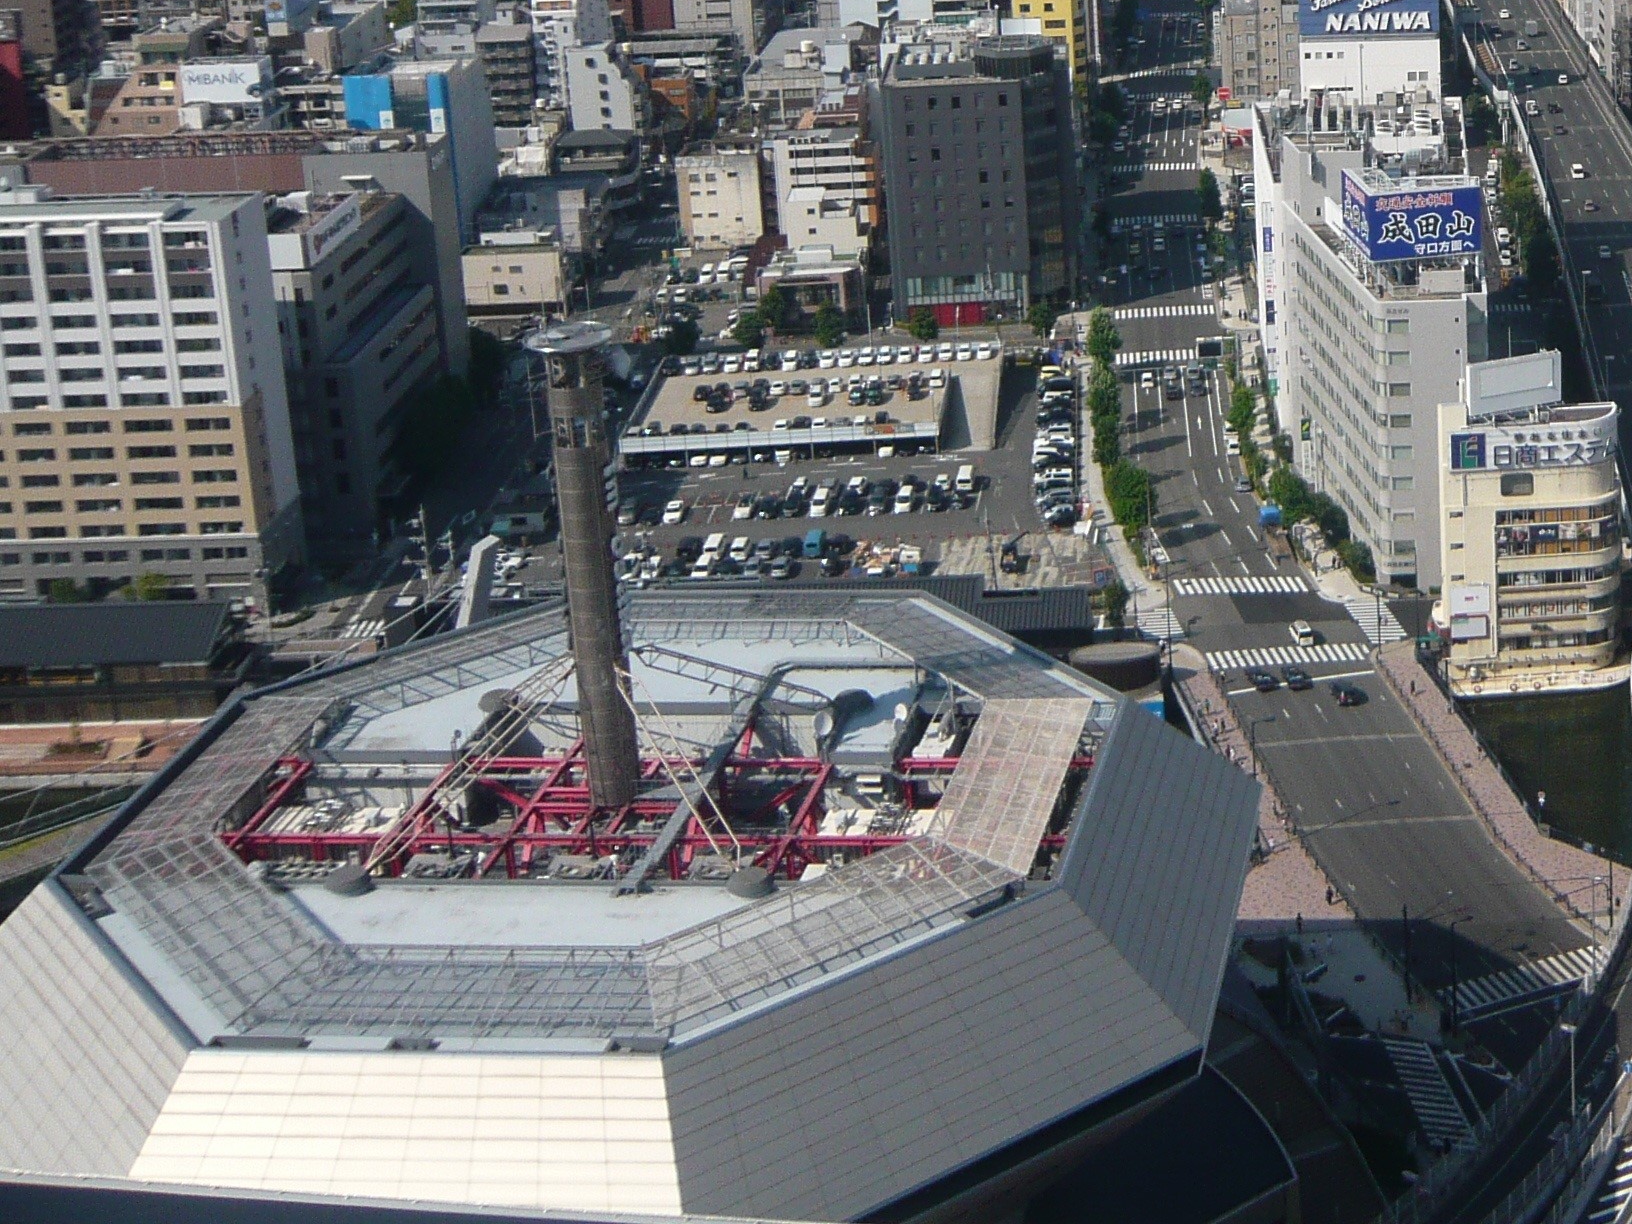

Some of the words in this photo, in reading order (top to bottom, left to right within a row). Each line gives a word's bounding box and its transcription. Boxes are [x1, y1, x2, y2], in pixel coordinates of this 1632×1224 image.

[1325, 11, 1431, 32] NANIWA
[1377, 210, 1475, 244] 成田山
[1414, 240, 1475, 254] 守口方面へ
[1494, 437, 1617, 467] 日商エステム
